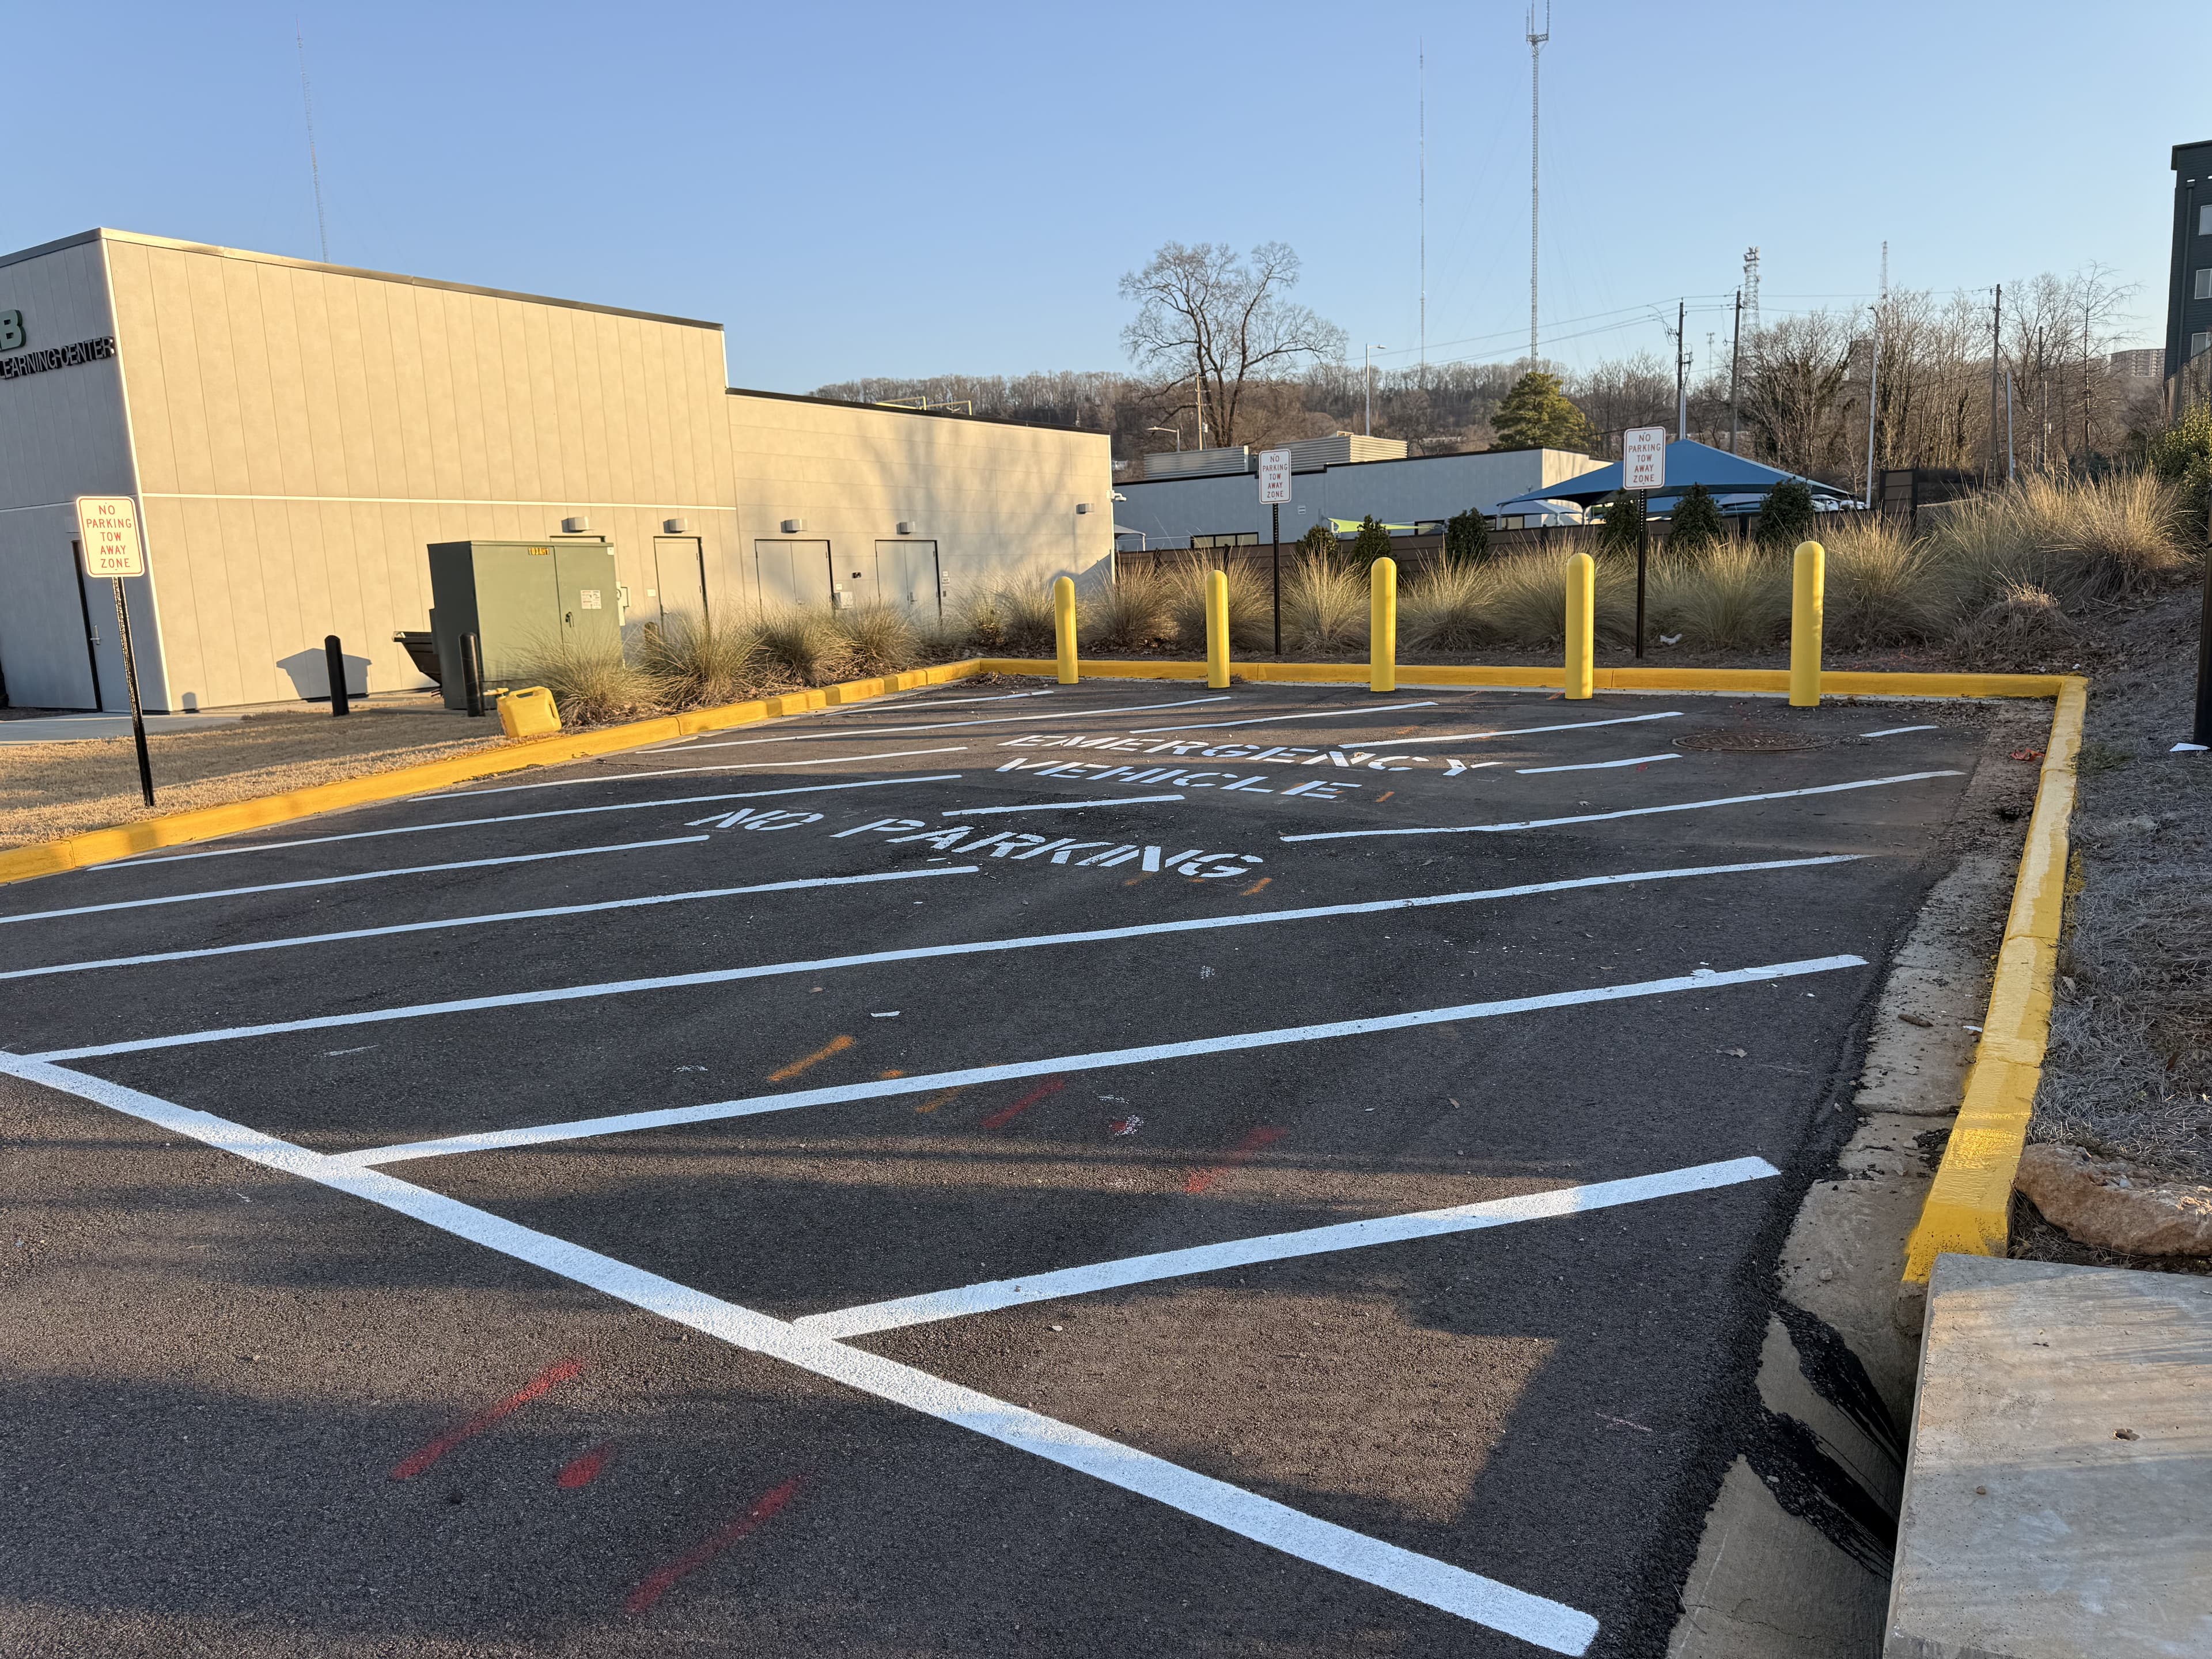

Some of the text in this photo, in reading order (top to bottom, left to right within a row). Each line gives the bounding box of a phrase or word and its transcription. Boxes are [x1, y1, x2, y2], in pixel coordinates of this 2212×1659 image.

[60, 336, 116, 366] CENTER
[1639, 434, 1651, 442] NO
[1628, 443, 1661, 453] PARKING
[1637, 454, 1652, 463] TOW
[1263, 464, 1287, 472] PARKING
[1634, 464, 1654, 473] AWAY
[1633, 474, 1654, 483] ZONE
[99, 505, 115, 515] NO
[86, 518, 131, 528] PARKING
[100, 532, 121, 541] TOW
[100, 545, 126, 555] AWAY
[101, 558, 130, 568] ZONE
[995, 734, 1503, 776] EMERGENCY
[995, 757, 1362, 799] VEHICLE
[684, 808, 1264, 877] NO PARKING
